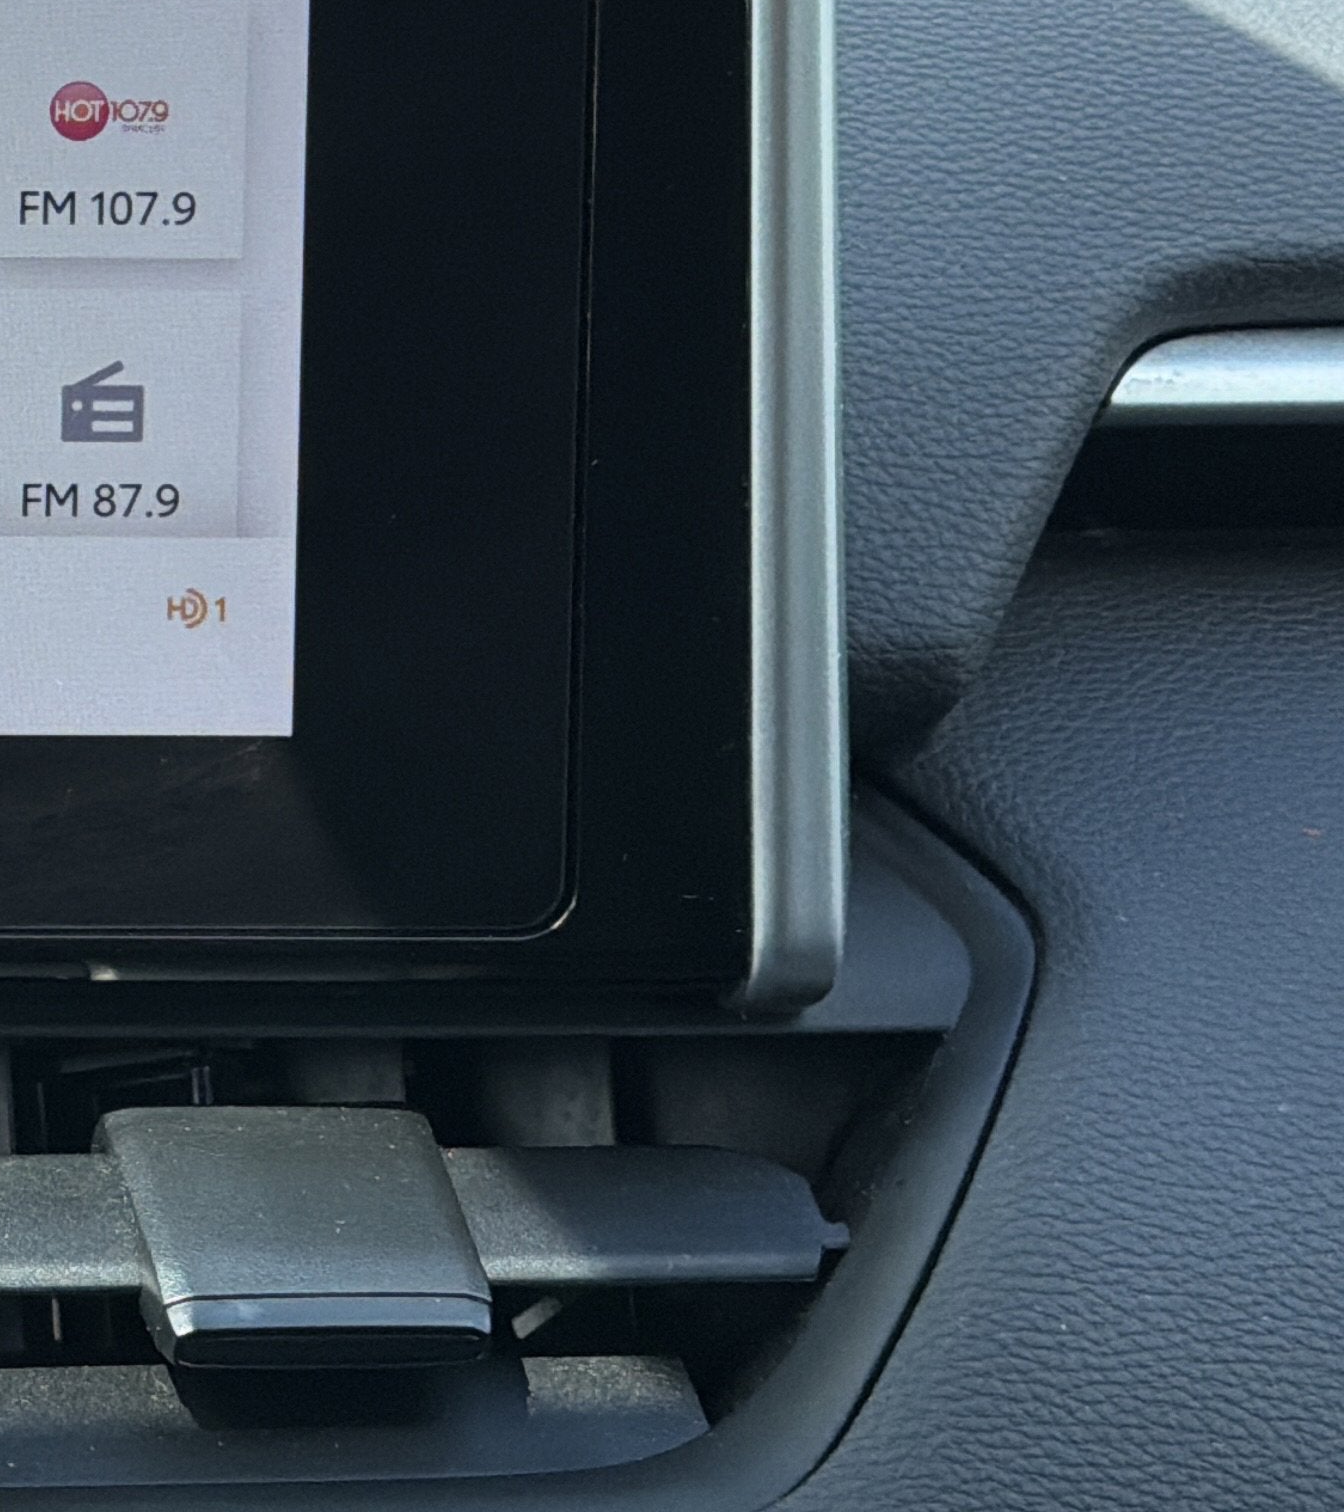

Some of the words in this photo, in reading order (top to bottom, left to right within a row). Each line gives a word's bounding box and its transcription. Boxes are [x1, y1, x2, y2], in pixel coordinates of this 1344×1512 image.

[54, 99, 105, 122] HOT
[19, 190, 76, 225] FM
[92, 190, 197, 226] 107.9
[21, 483, 79, 517] FM
[93, 483, 180, 518] 87.9
